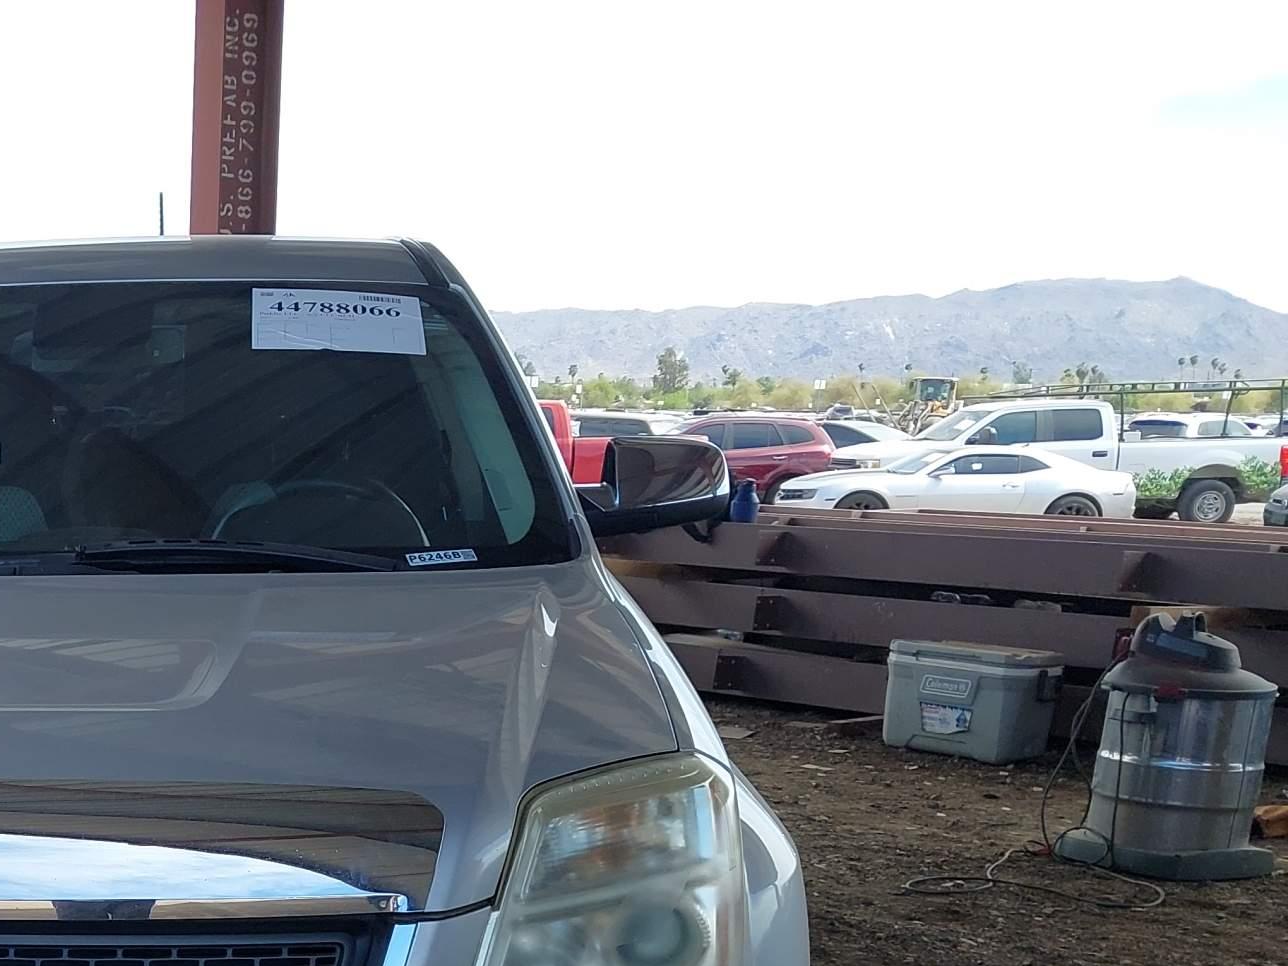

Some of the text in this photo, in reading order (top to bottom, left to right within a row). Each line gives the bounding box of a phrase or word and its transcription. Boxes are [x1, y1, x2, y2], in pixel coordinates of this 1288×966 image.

[224, 8, 240, 58] INC.
[221, 75, 237, 178] PREFAB
[269, 301, 401, 318] 44788066
[409, 551, 462, 563] P6246B
